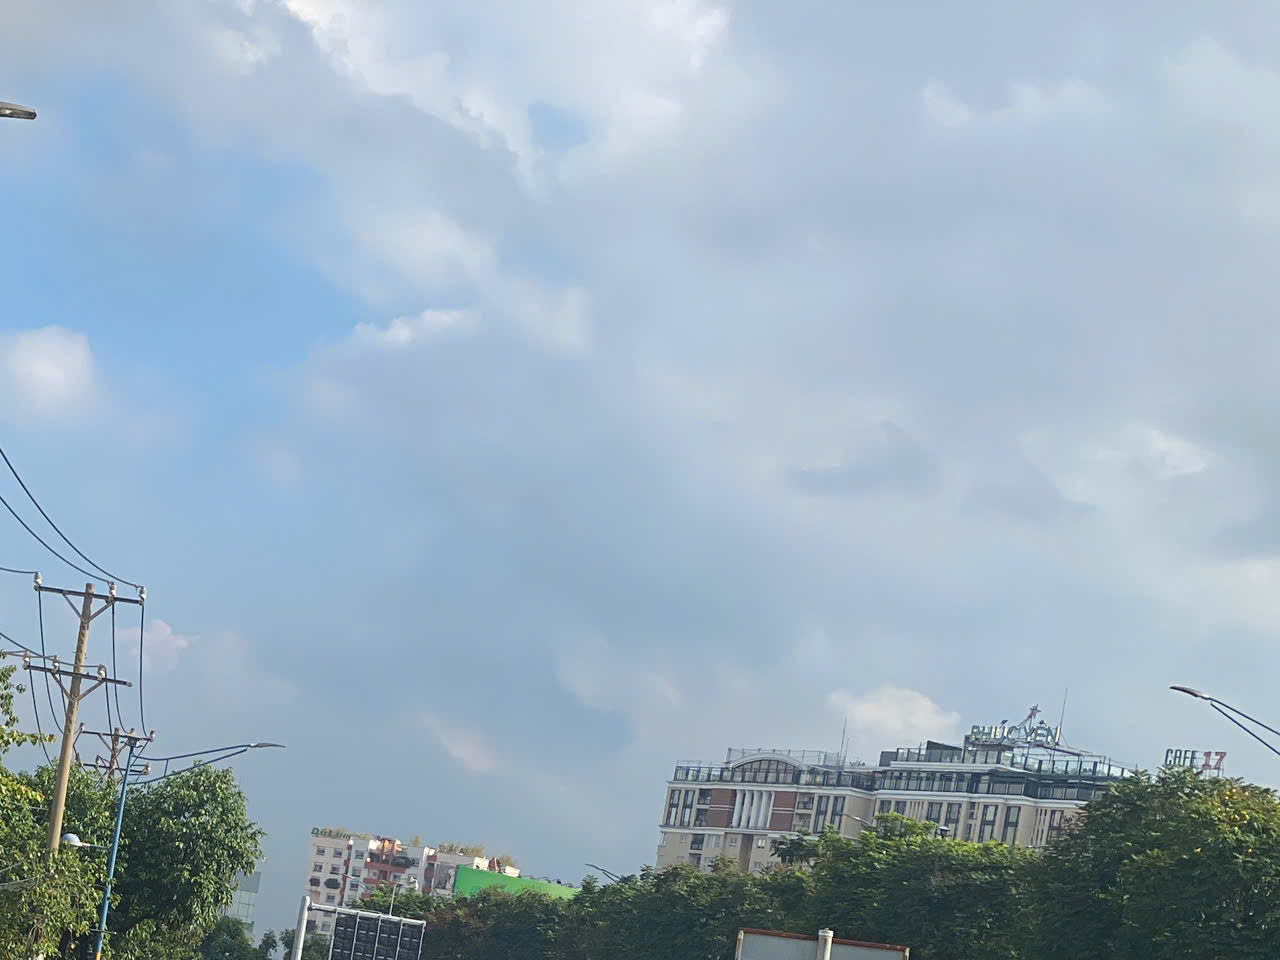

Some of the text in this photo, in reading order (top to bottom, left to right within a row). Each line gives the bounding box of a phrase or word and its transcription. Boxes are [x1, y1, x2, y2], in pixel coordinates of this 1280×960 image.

[970, 720, 1060, 746] PHÚC YÊN
[1164, 748, 1227, 770] CAFE 17
